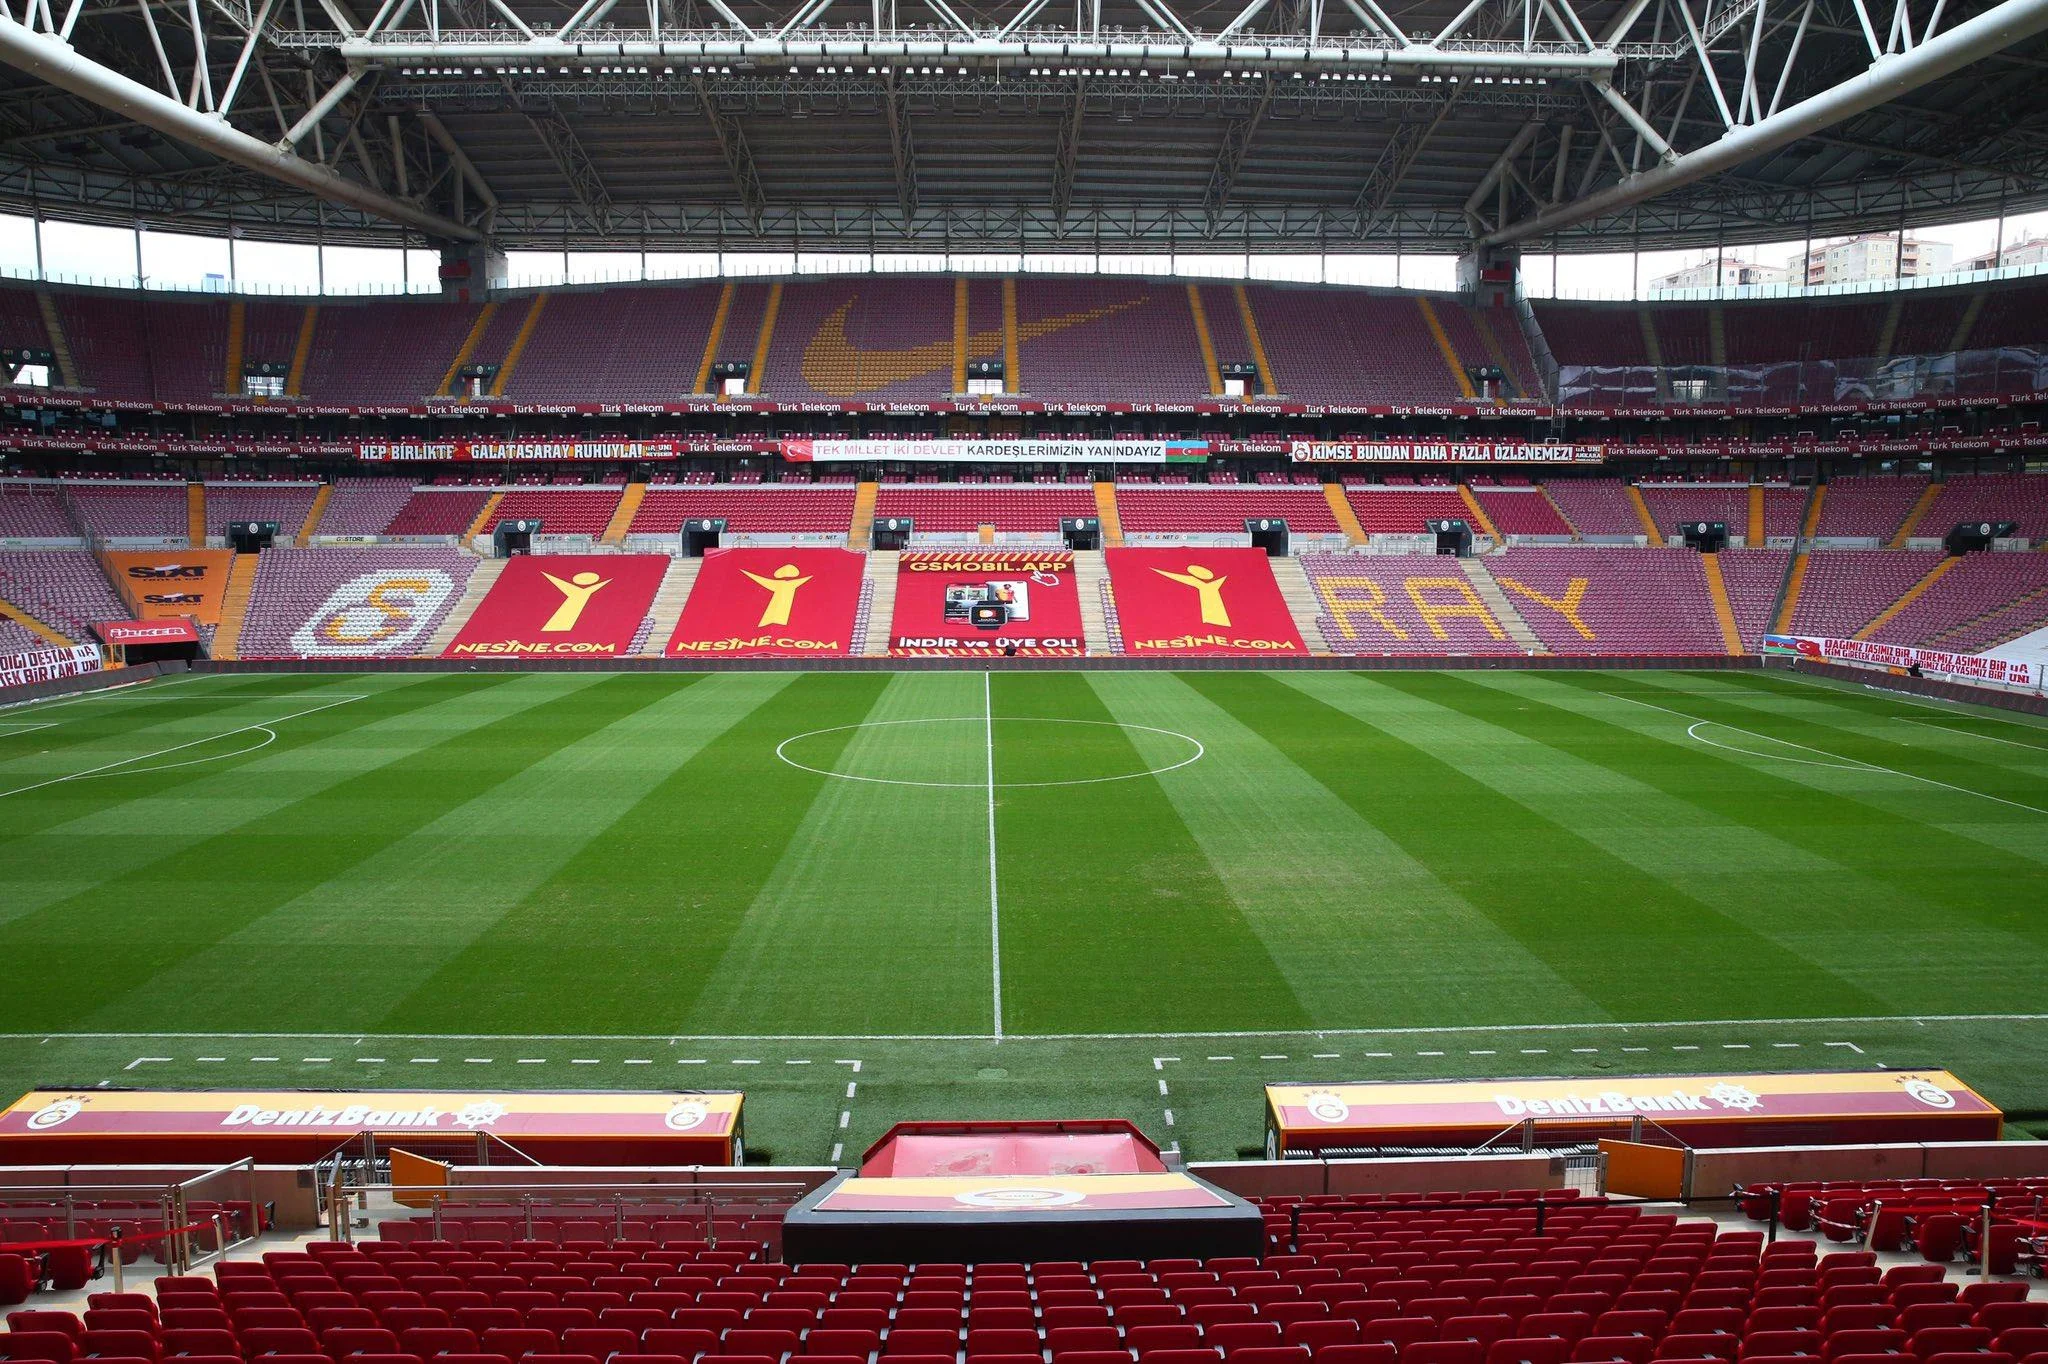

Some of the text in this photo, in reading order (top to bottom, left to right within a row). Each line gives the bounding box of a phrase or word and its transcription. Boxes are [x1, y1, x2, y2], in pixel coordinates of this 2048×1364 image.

[18, 396, 82, 406] Türk Telekom
[1937, 397, 1998, 407] Türk Telekom
[2010, 394, 2031, 402] Türk
[92, 399, 154, 409] Türk Telekom
[164, 402, 222, 412] Türk Telekom
[232, 404, 250, 412] Türk
[514, 404, 576, 413] Türk Telekom
[601, 404, 664, 412] Türk Telekom
[689, 403, 752, 412] Türk Telekom
[777, 403, 840, 411] Türk Telekom
[866, 403, 930, 411] Türk Telekom
[954, 403, 1018, 411] Türk Telekom
[1043, 403, 1106, 411] Türk Telekom
[1131, 403, 1194, 412] Türk Telekom
[1219, 404, 1281, 412] Türk Telekom
[1821, 403, 1857, 412] Telekom
[1867, 401, 1927, 410] Türk Telekom
[297, 406, 350, 414] Türk Telekom
[358, 406, 408, 414] Türk Telekom
[426, 406, 489, 414] Türk Telekom
[1306, 405, 1367, 414] Türk Telekom
[1391, 406, 1452, 415] Türk Telekom
[1476, 406, 1536, 416] Türk Telekom
[1574, 408, 1604, 416] Telekom
[1633, 408, 1664, 416] Telekom
[1756, 406, 1790, 414] Telekom
[22, 440, 86, 449] Türk Telekom
[96, 442, 157, 451] Türk Telekom
[1928, 440, 1989, 450] Türk Telekom
[2000, 438, 2020, 446] Türk
[190, 444, 226, 452] Telekom
[360, 444, 642, 459] HEP BİRLİKTE GALATASARAY RUHUYLA!
[689, 443, 752, 451] Türk Telekom
[816, 444, 1161, 458] TEK MİLLET İKİ DEVLET KARDEŞLERİMİZİN YANINDAYIZ
[1219, 444, 1281, 452] Türk Telekom
[1313, 443, 1572, 460] KİMSE BUNDAN DAHA FAZLA ÖZLENEMEZ!
[1687, 447, 1719, 455] Telekom
[1749, 446, 1782, 454] Telekom
[1813, 444, 1849, 452] Telekom
[1859, 442, 1918, 452] Türk Telekom
[110, 628, 187, 638] ÜLKER
[964, 639, 989, 648] ve
[996, 638, 1036, 648] ÜYE
[1040, 638, 1078, 648] OL!
[28, 648, 75, 667] DESTAN
[1494, 1092, 1711, 1116] DenizBank
[220, 1104, 447, 1126] DenizBank
